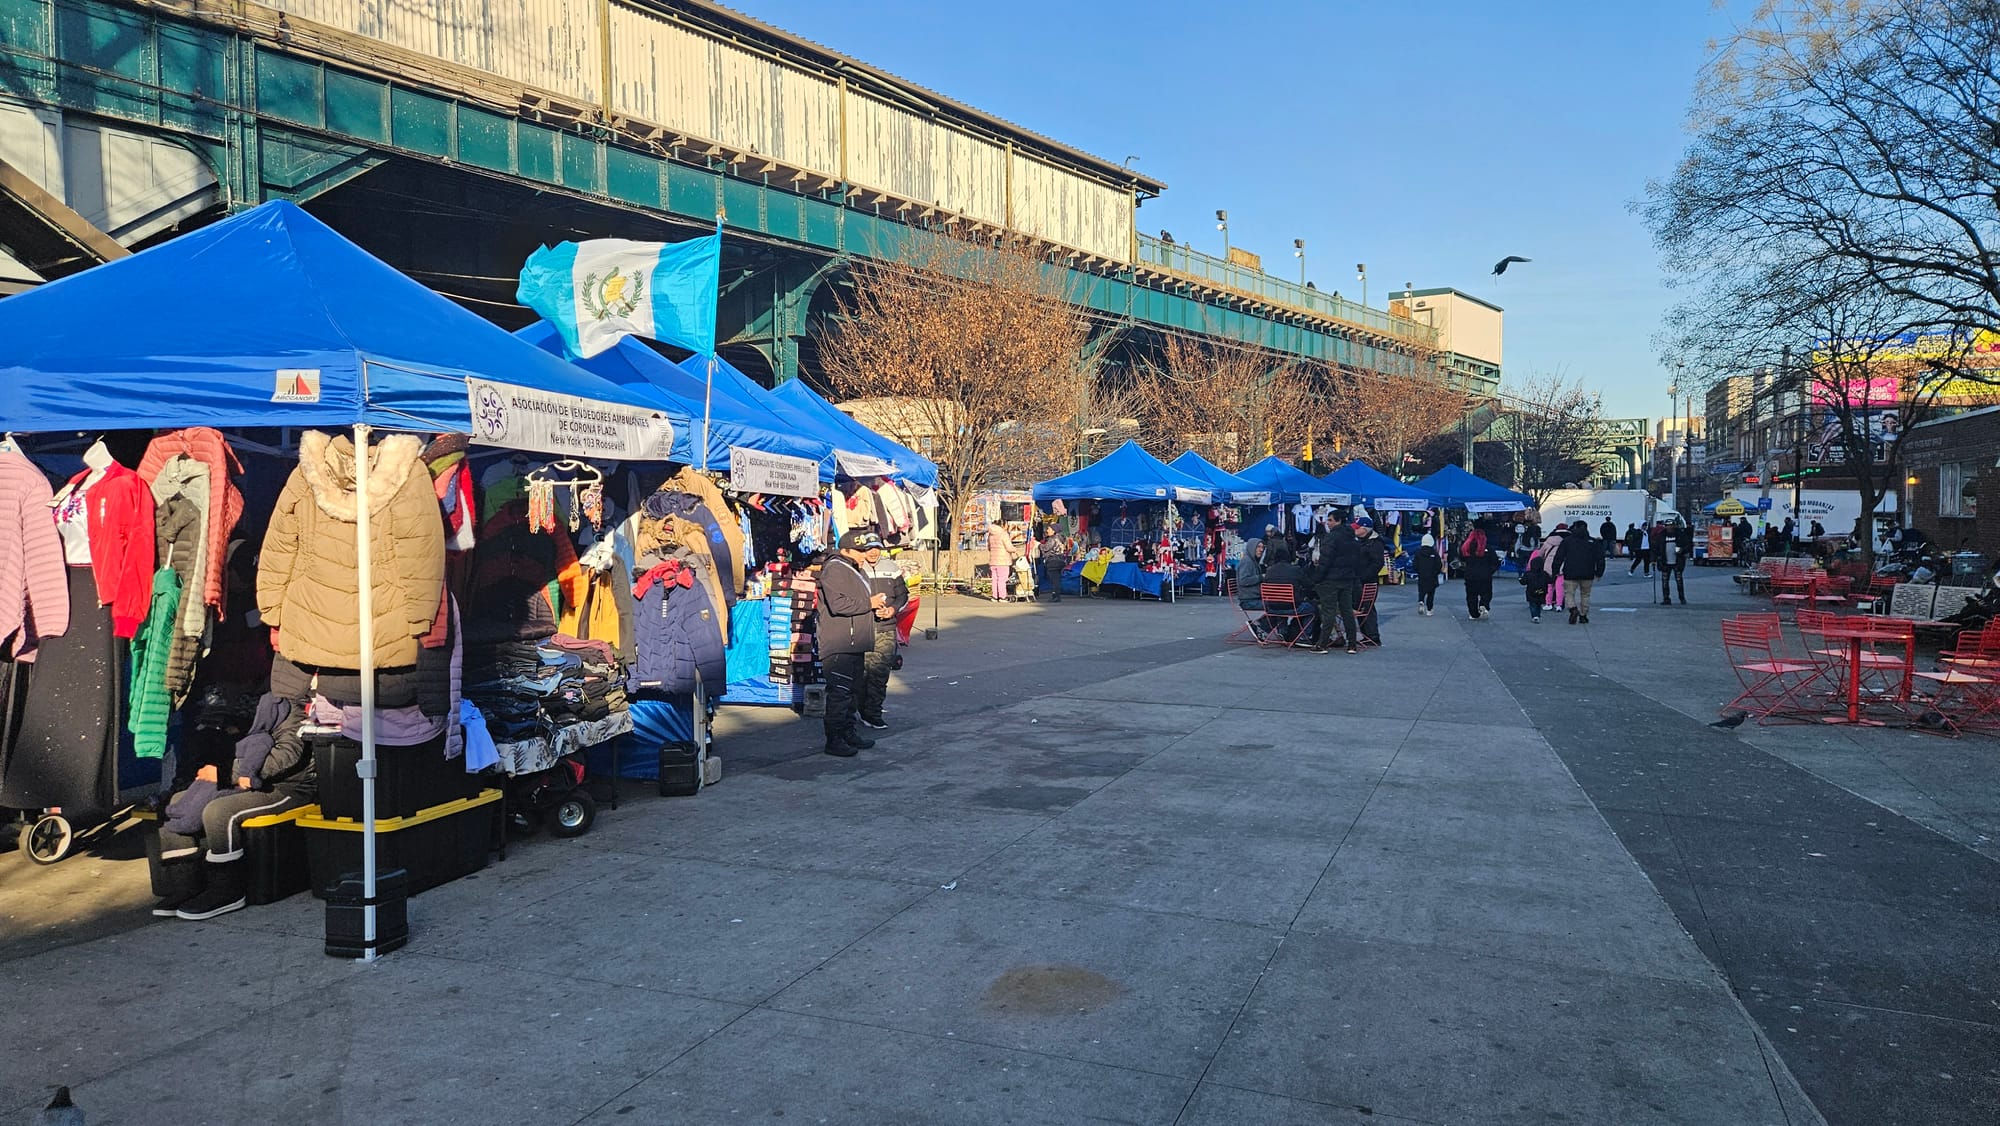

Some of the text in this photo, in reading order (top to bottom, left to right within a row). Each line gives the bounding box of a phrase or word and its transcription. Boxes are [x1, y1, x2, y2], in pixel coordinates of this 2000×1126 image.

[559, 405, 569, 416] DE
[570, 407, 611, 422] VENDEDORES
[612, 413, 649, 428] AMBULANTES
[559, 420, 617, 436] DE CORONA PLAZA
[550, 432, 626, 451] New York 103 Roosevelt
